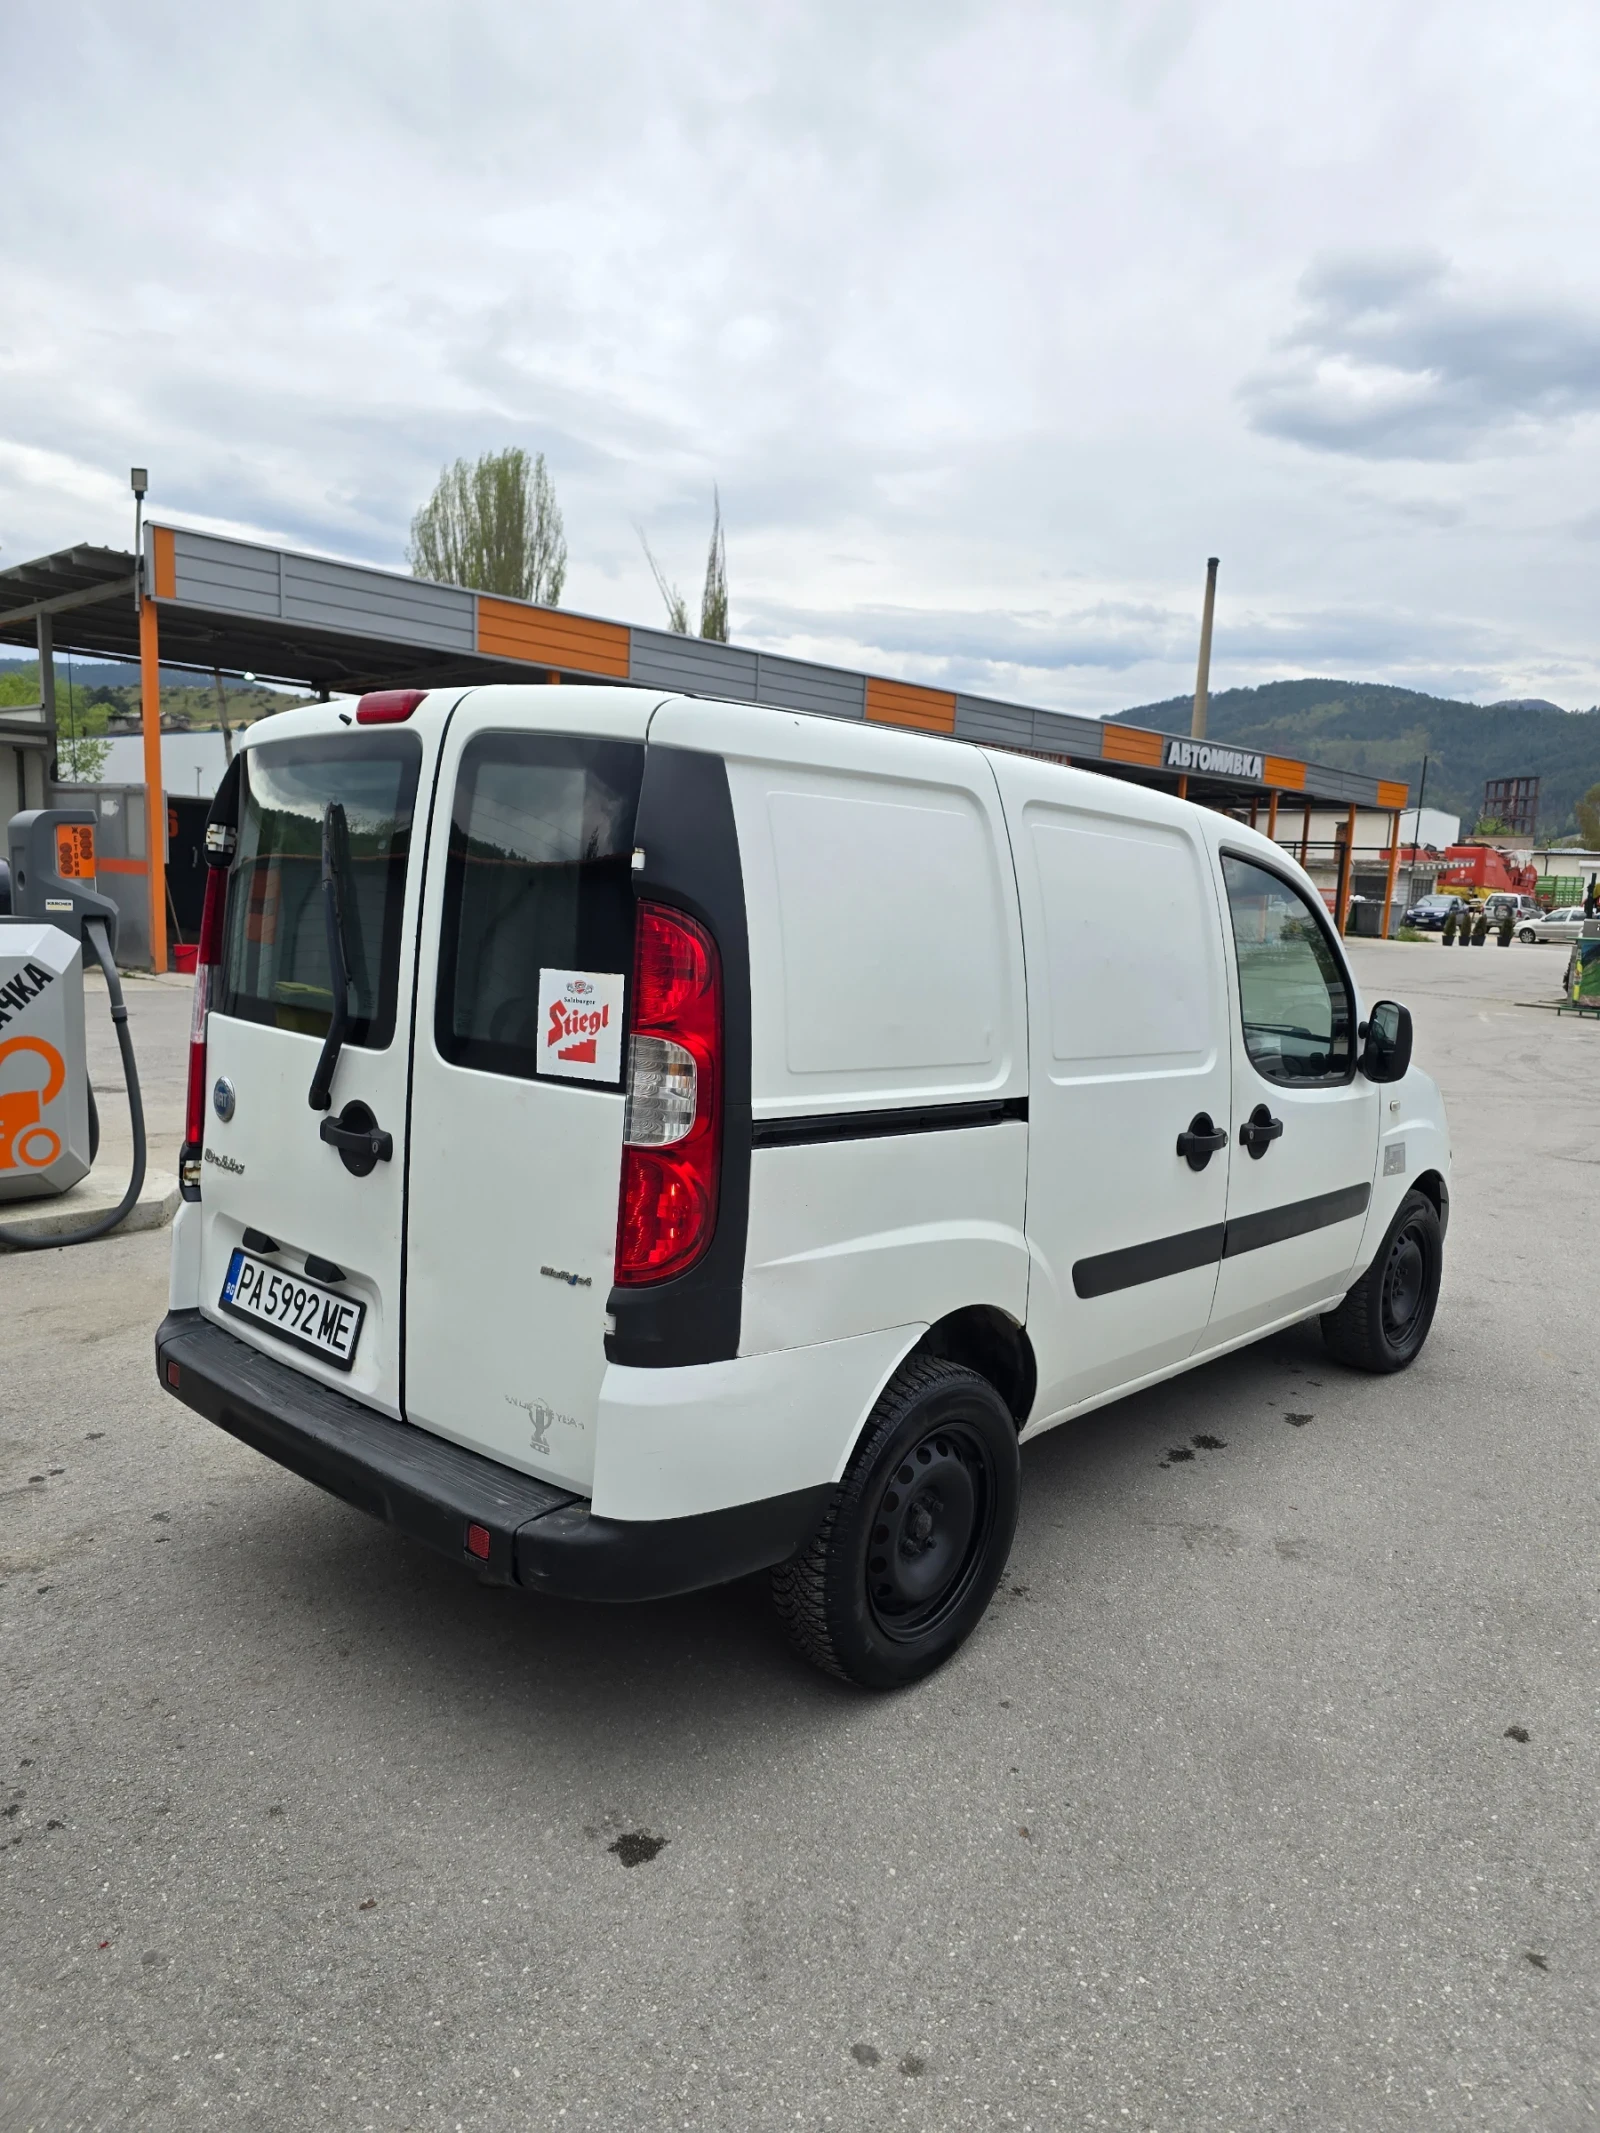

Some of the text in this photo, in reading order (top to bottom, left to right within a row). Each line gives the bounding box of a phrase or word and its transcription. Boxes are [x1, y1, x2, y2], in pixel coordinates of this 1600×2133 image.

[1168, 742, 1262, 778] АВТОМИВКА
[71, 826, 80, 877] ЖЕТОНИ
[564, 996, 596, 1006] Salzburger
[547, 999, 609, 1047] Stiegl
[225, 1282, 235, 1296] BG
